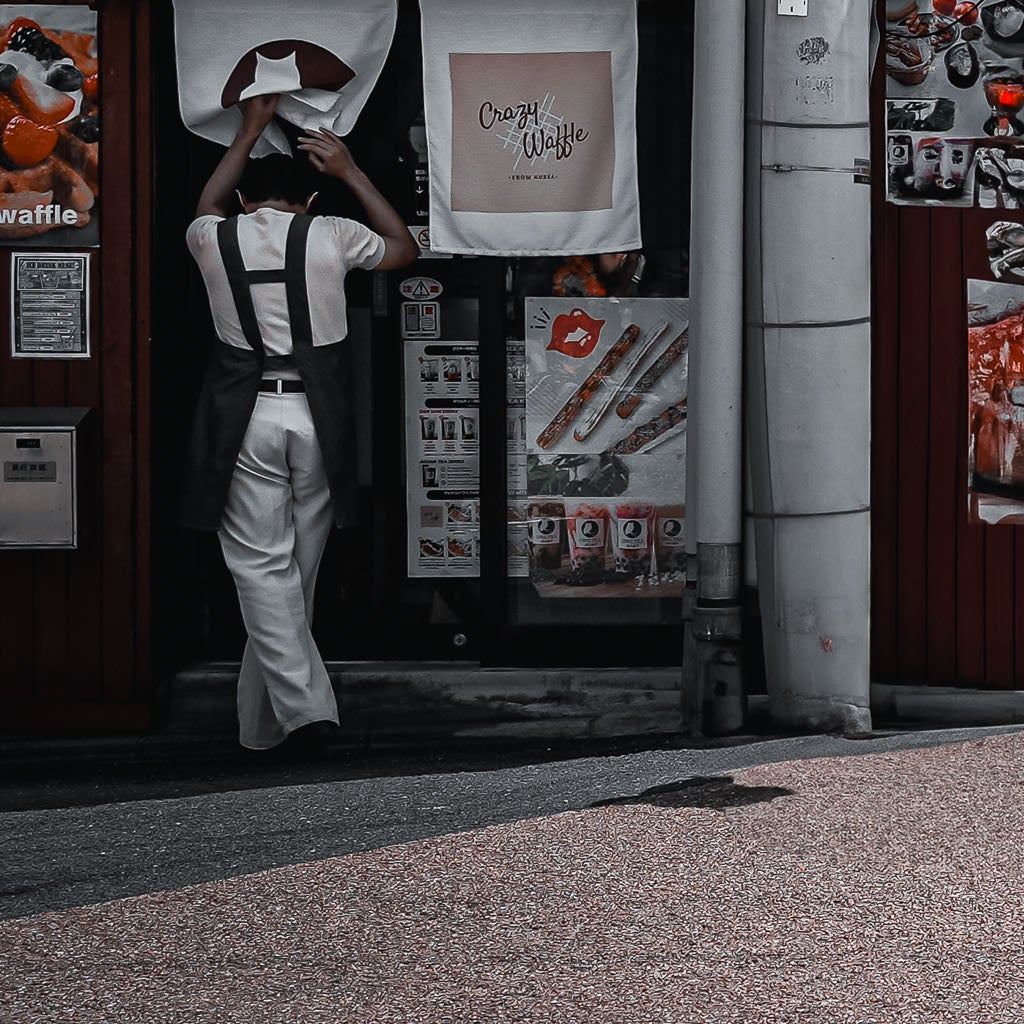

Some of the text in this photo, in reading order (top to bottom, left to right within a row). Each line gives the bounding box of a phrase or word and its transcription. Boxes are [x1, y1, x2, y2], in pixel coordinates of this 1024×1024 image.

[479, 101, 539, 130] Crazy
[523, 121, 590, 161] Waffle
[0, 204, 78, 225] waffle
